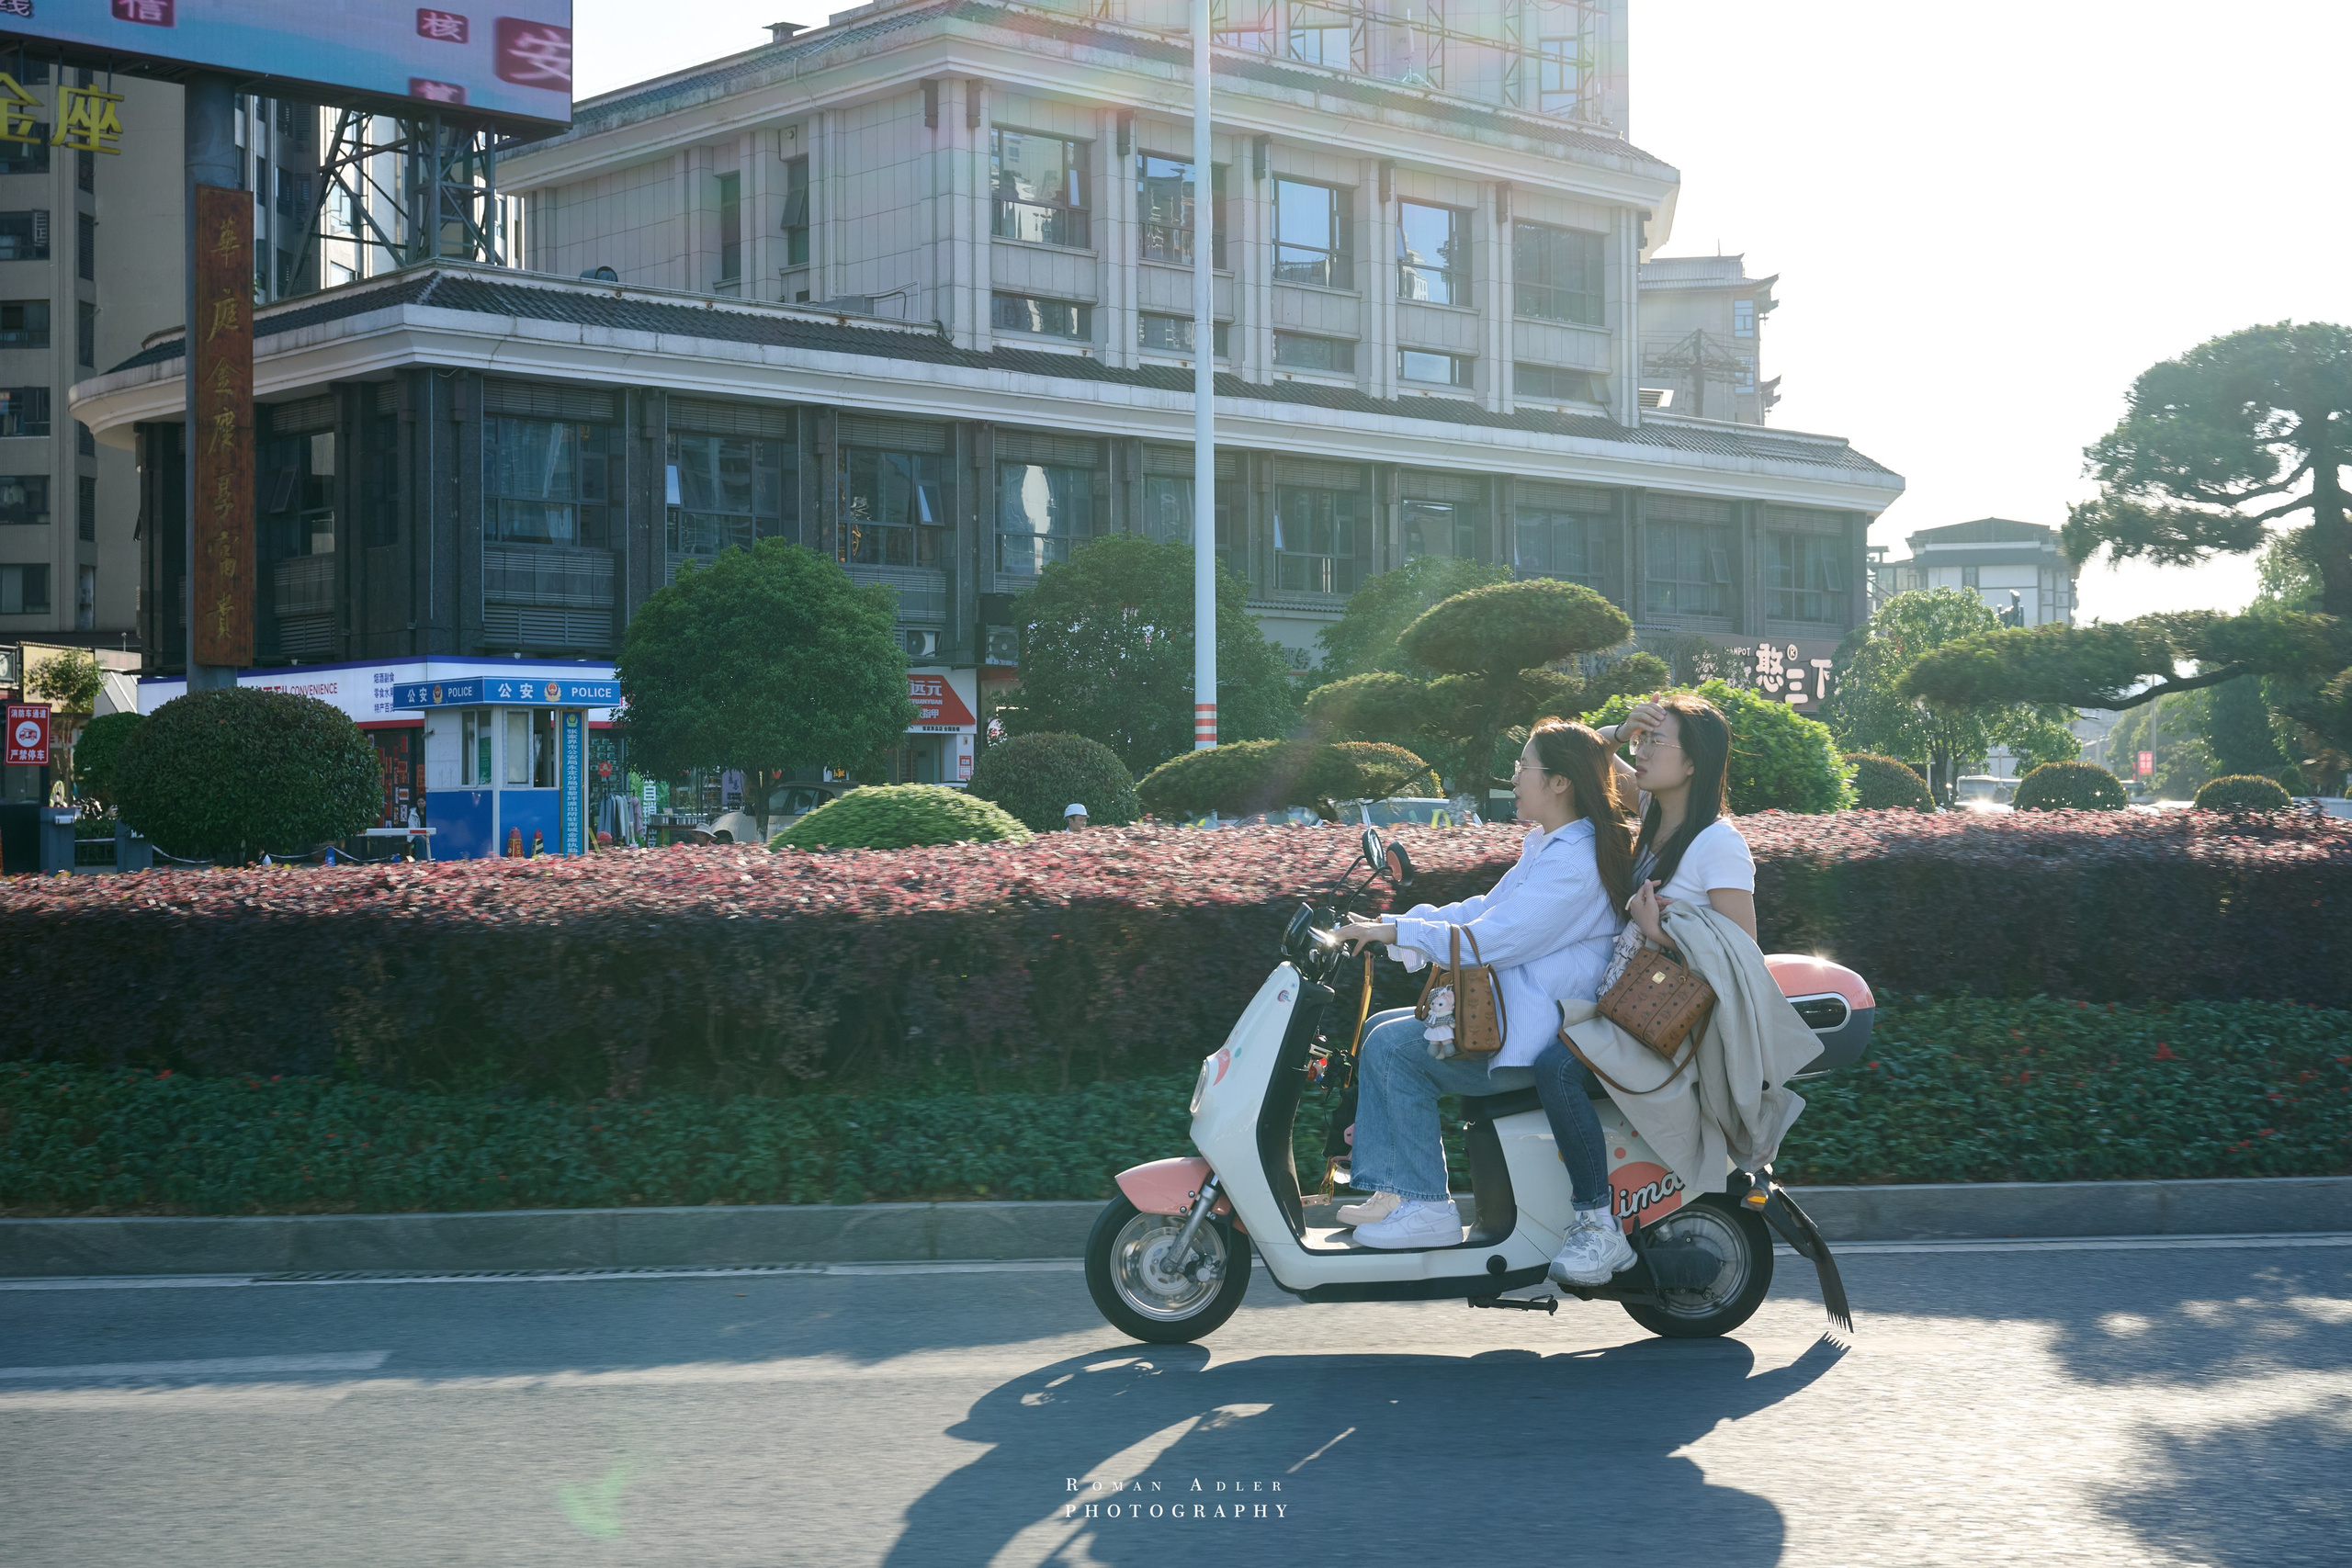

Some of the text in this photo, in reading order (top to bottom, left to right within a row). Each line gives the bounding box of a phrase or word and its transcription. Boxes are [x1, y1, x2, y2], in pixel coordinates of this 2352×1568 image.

[422, 12, 466, 41] 核
[407, 686, 428, 704] 公安
[447, 686, 473, 698] POLICE
[497, 682, 534, 699] 公安
[571, 687, 613, 698] POLICE
[907, 680, 943, 696] 远元
[10, 708, 47, 718] 消防车通道
[10, 750, 45, 761] 严禁停车
